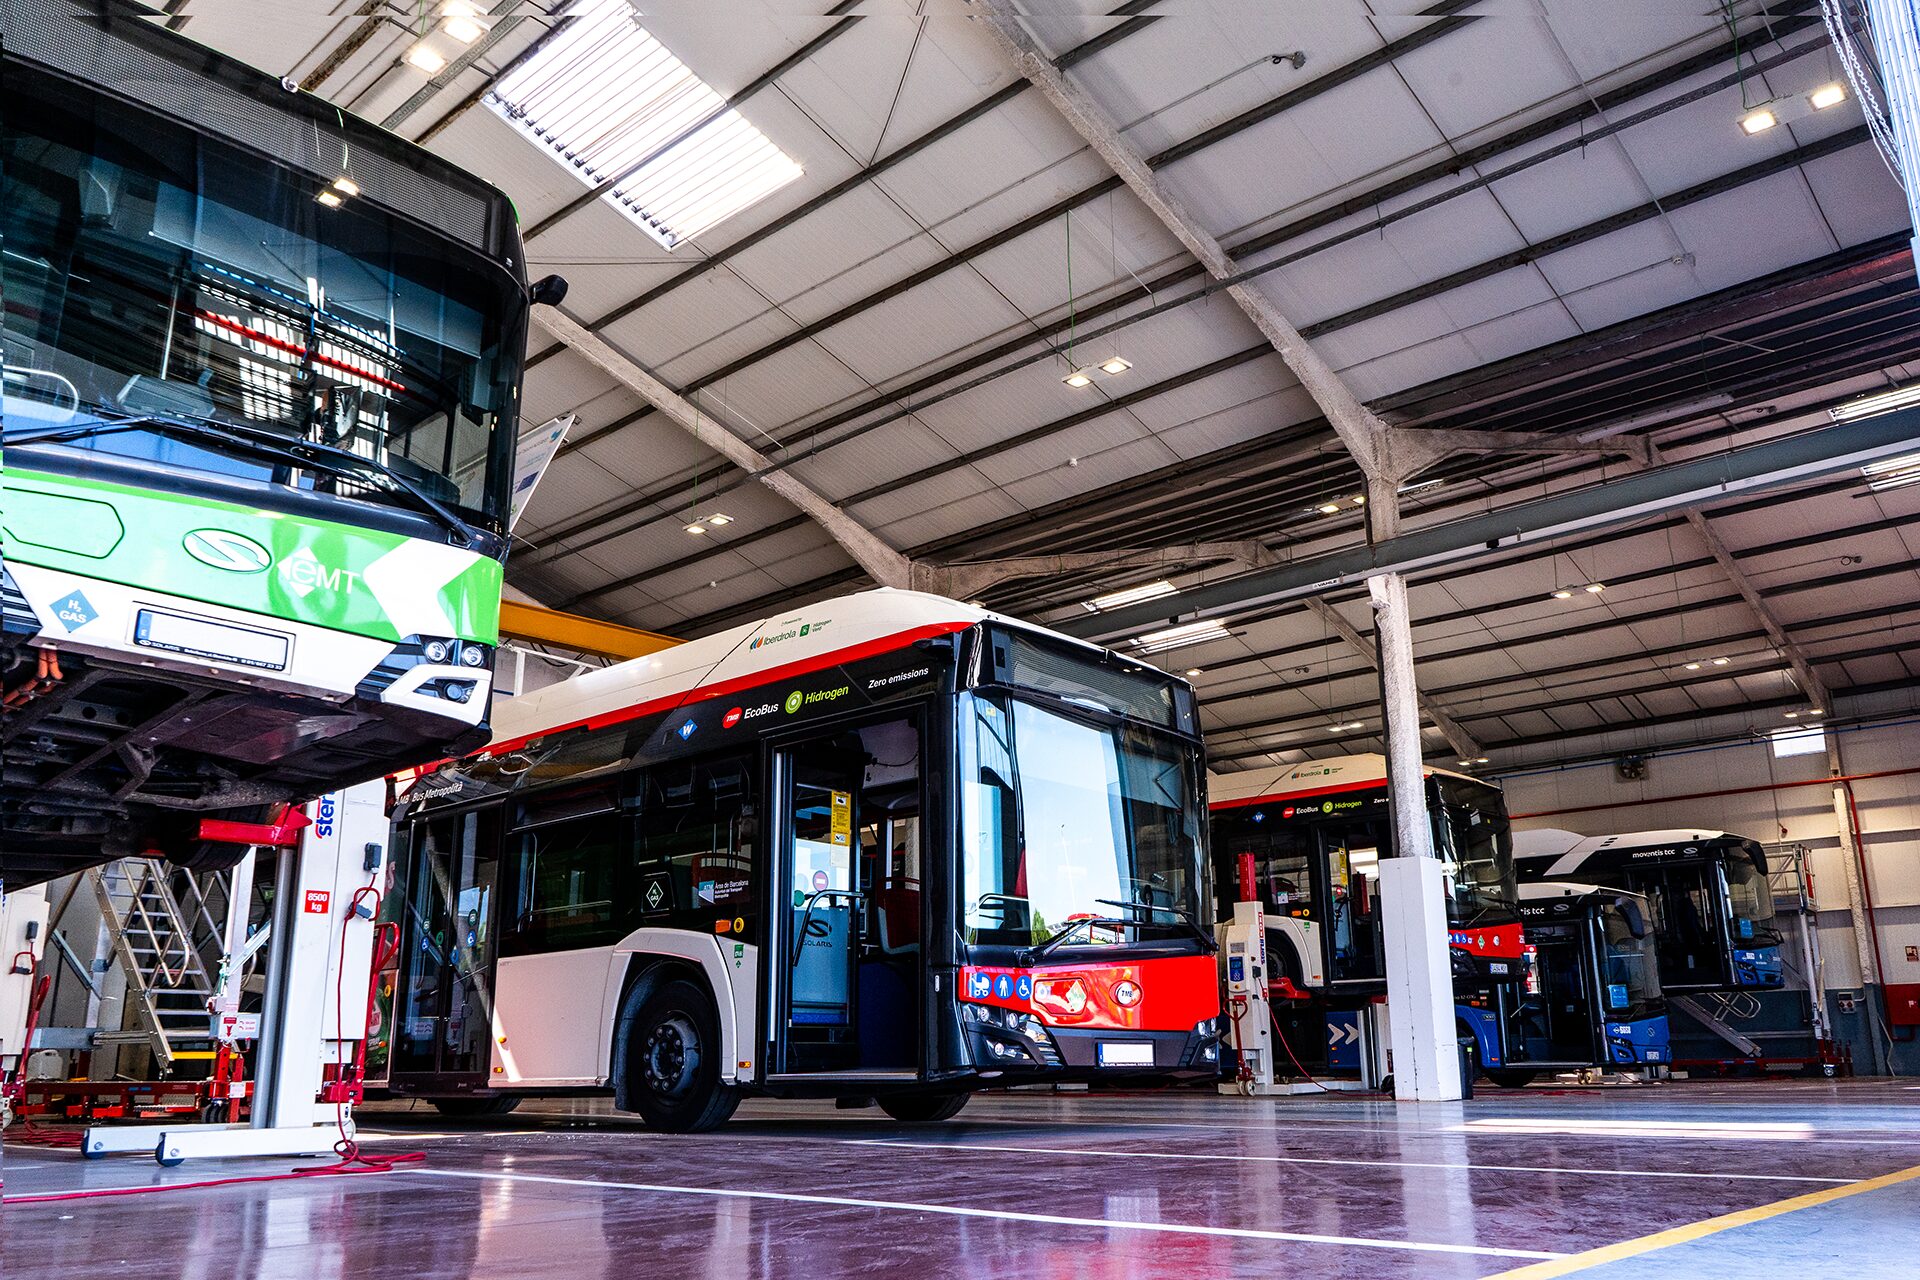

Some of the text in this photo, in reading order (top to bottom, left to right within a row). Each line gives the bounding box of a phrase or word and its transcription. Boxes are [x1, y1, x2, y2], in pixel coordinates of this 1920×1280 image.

[59, 609, 87, 623] GAS
[763, 629, 796, 646] Iberdrola
[151, 641, 180, 652] SOLARIS
[868, 666, 929, 689] Zero emissions
[805, 686, 849, 704] Hidrogen
[743, 702, 779, 720] EcoBus
[682, 724, 693, 735] W
[411, 792, 424, 803] Bus
[424, 781, 463, 800] Metropolità
[1296, 806, 1319, 814] EcoBus
[1334, 801, 1362, 809] Hidrogen
[729, 880, 749, 888] Barcelona
[307, 892, 328, 902] 8500
[311, 902, 322, 912] kg
